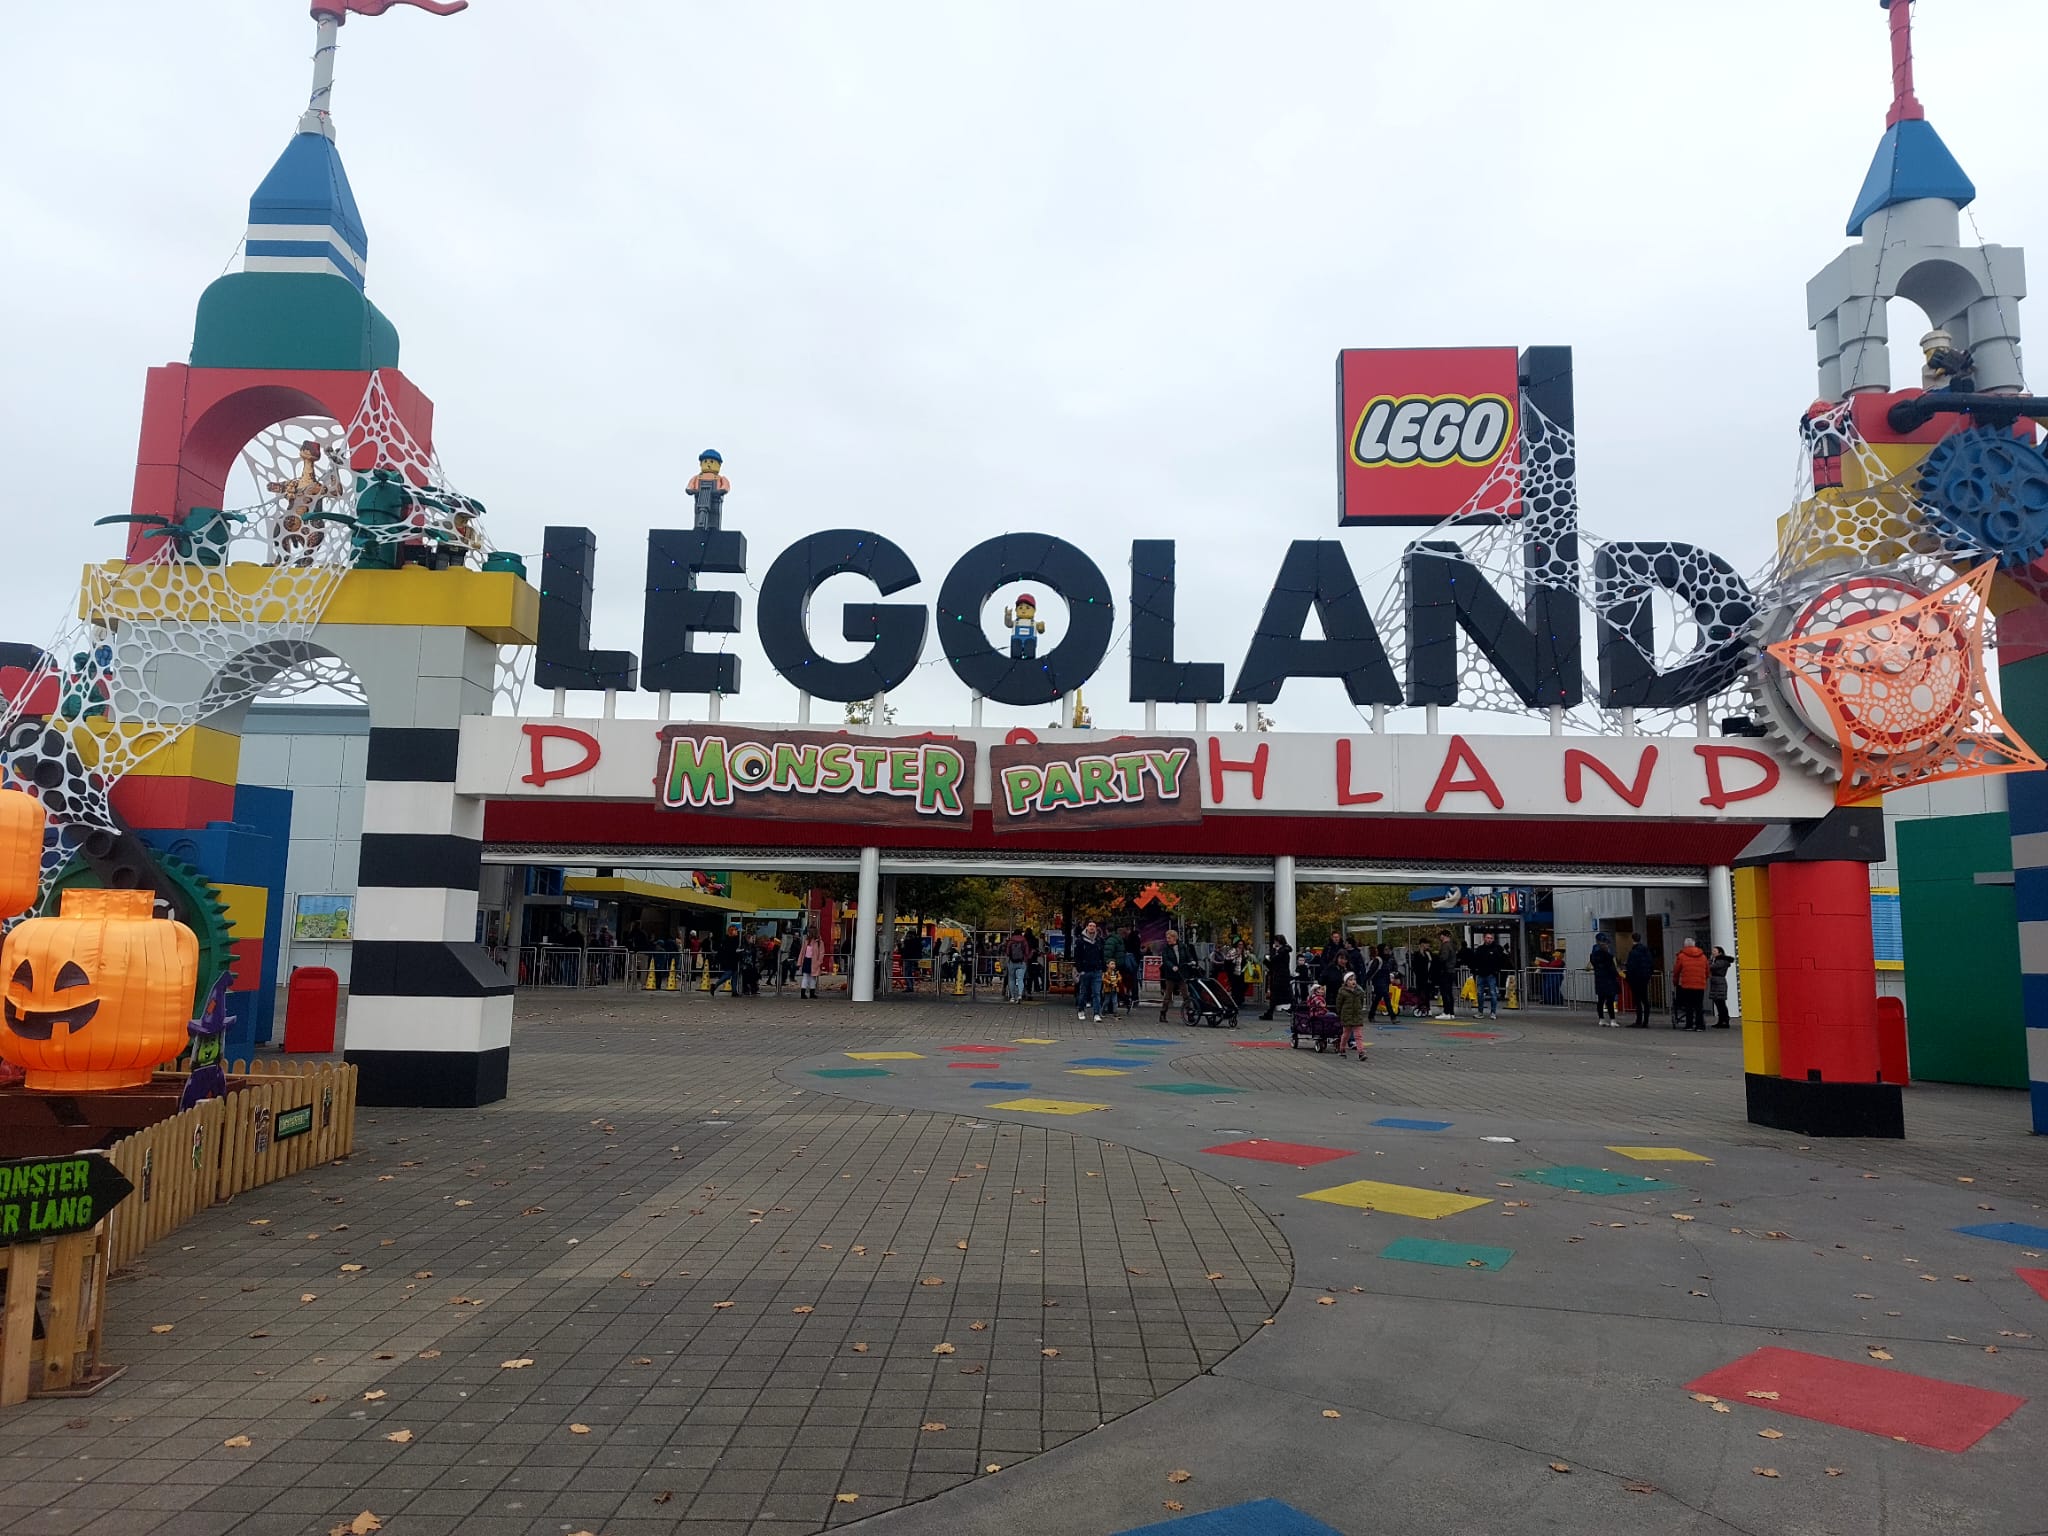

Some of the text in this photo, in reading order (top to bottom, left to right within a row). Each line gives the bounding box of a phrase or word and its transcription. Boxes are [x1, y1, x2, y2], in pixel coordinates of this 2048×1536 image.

[1351, 394, 1514, 468] LEGO
[535, 345, 1762, 709] LEGOLAND
[522, 724, 1780, 810] DHLAND
[664, 736, 1190, 816] MONSTER PARTY
[1468, 892, 1524, 914] BOUTIQUE
[29, 1195, 93, 1232] LANG
